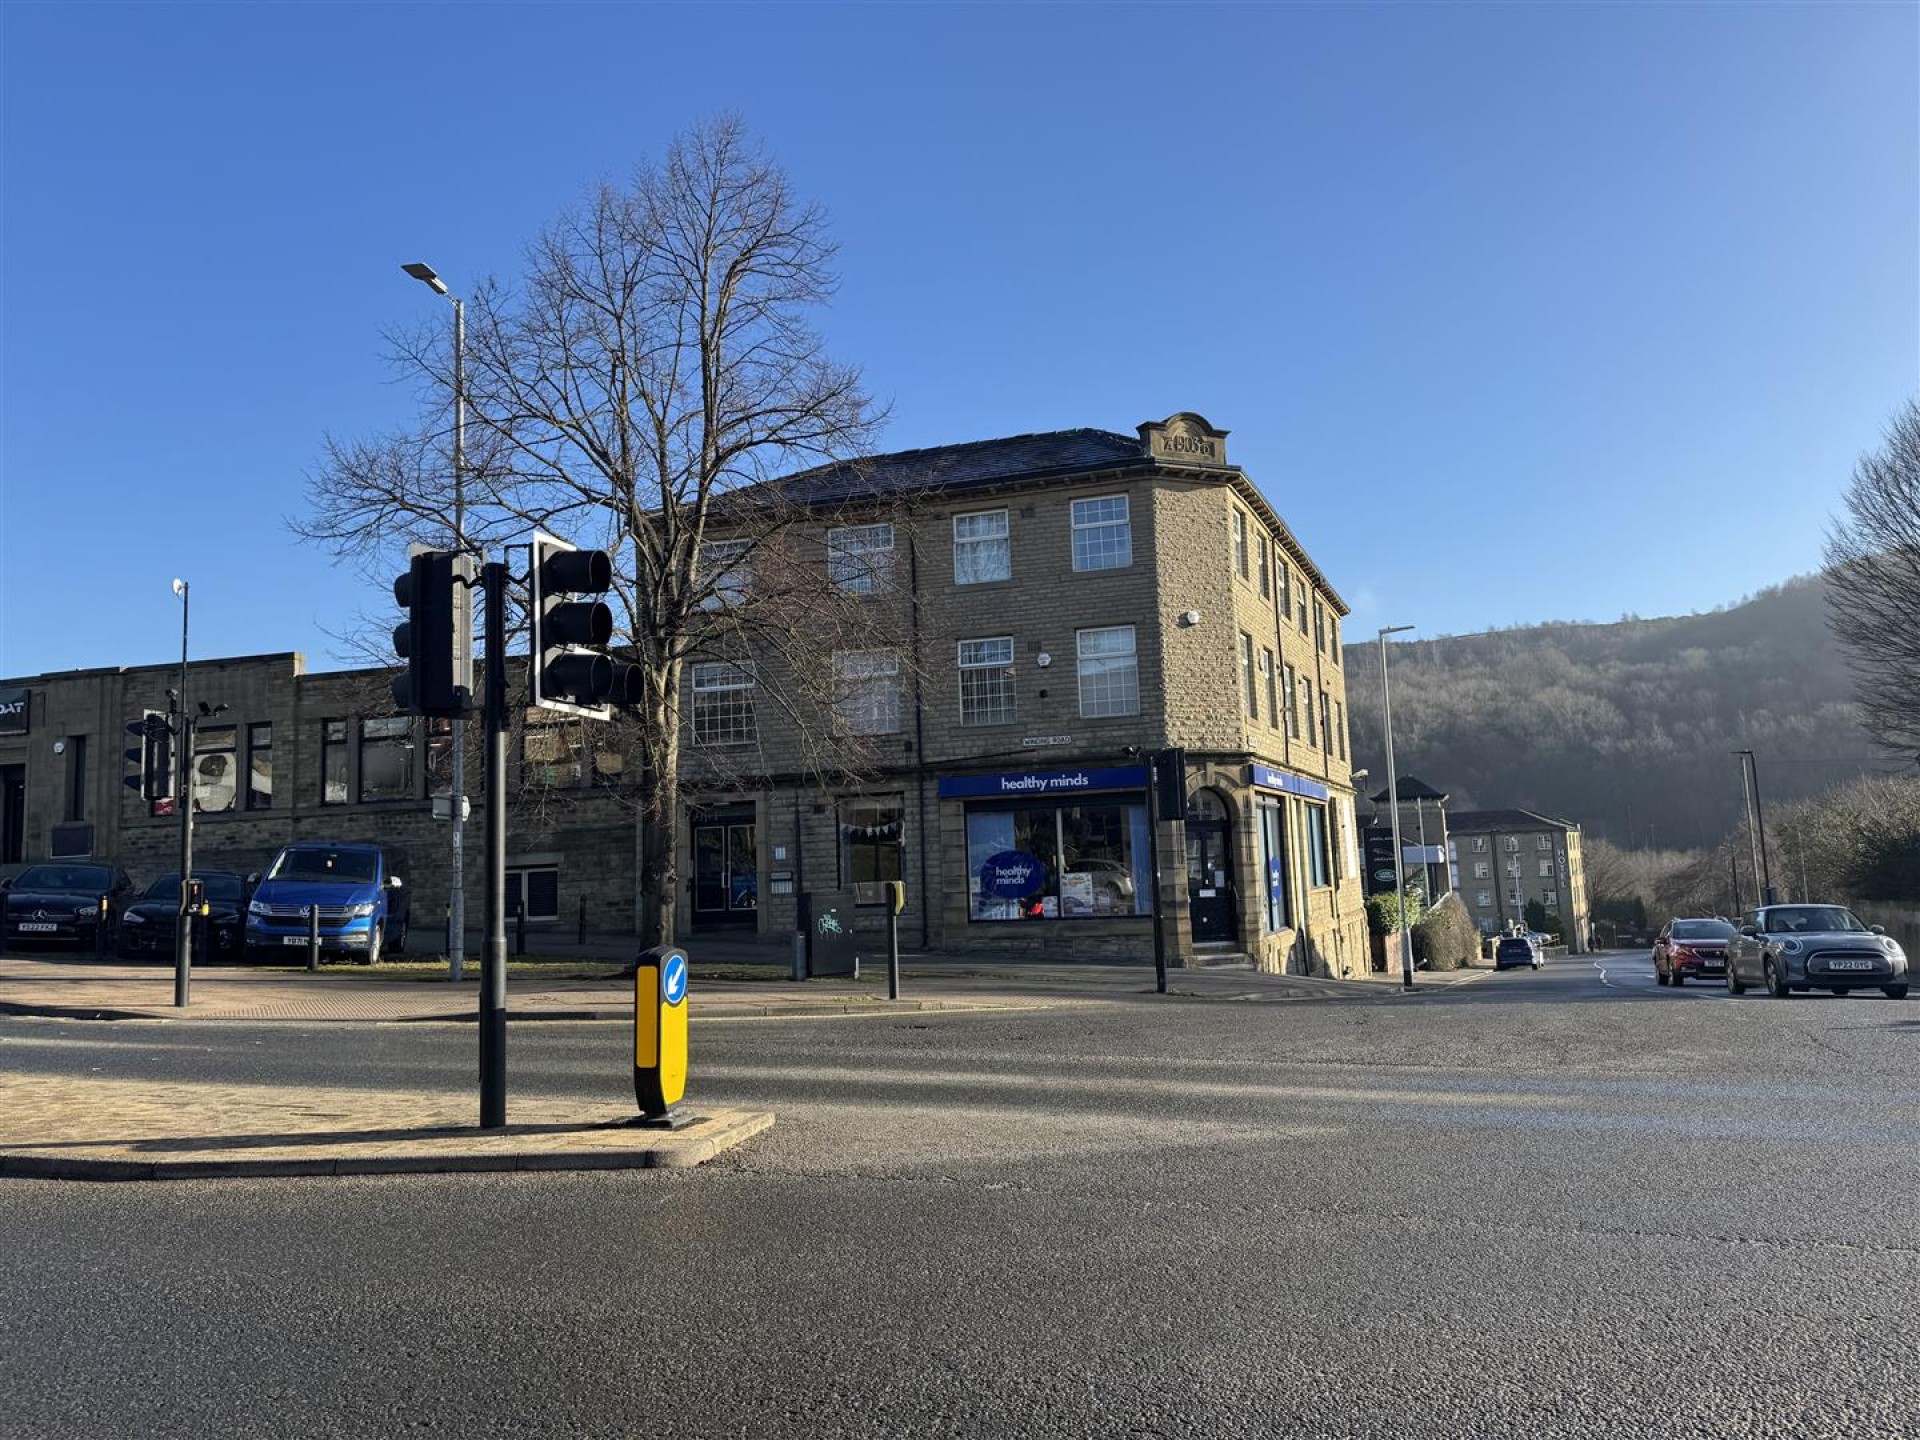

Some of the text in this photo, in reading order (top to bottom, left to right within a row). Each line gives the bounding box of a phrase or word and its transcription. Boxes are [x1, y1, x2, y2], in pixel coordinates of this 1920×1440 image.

[1001, 773, 1089, 791] healthy minds
[995, 866, 1031, 878] healthy
[1557, 849, 1567, 888] HOTEL
[996, 876, 1025, 885] minds
[1833, 960, 1853, 969] YP22
